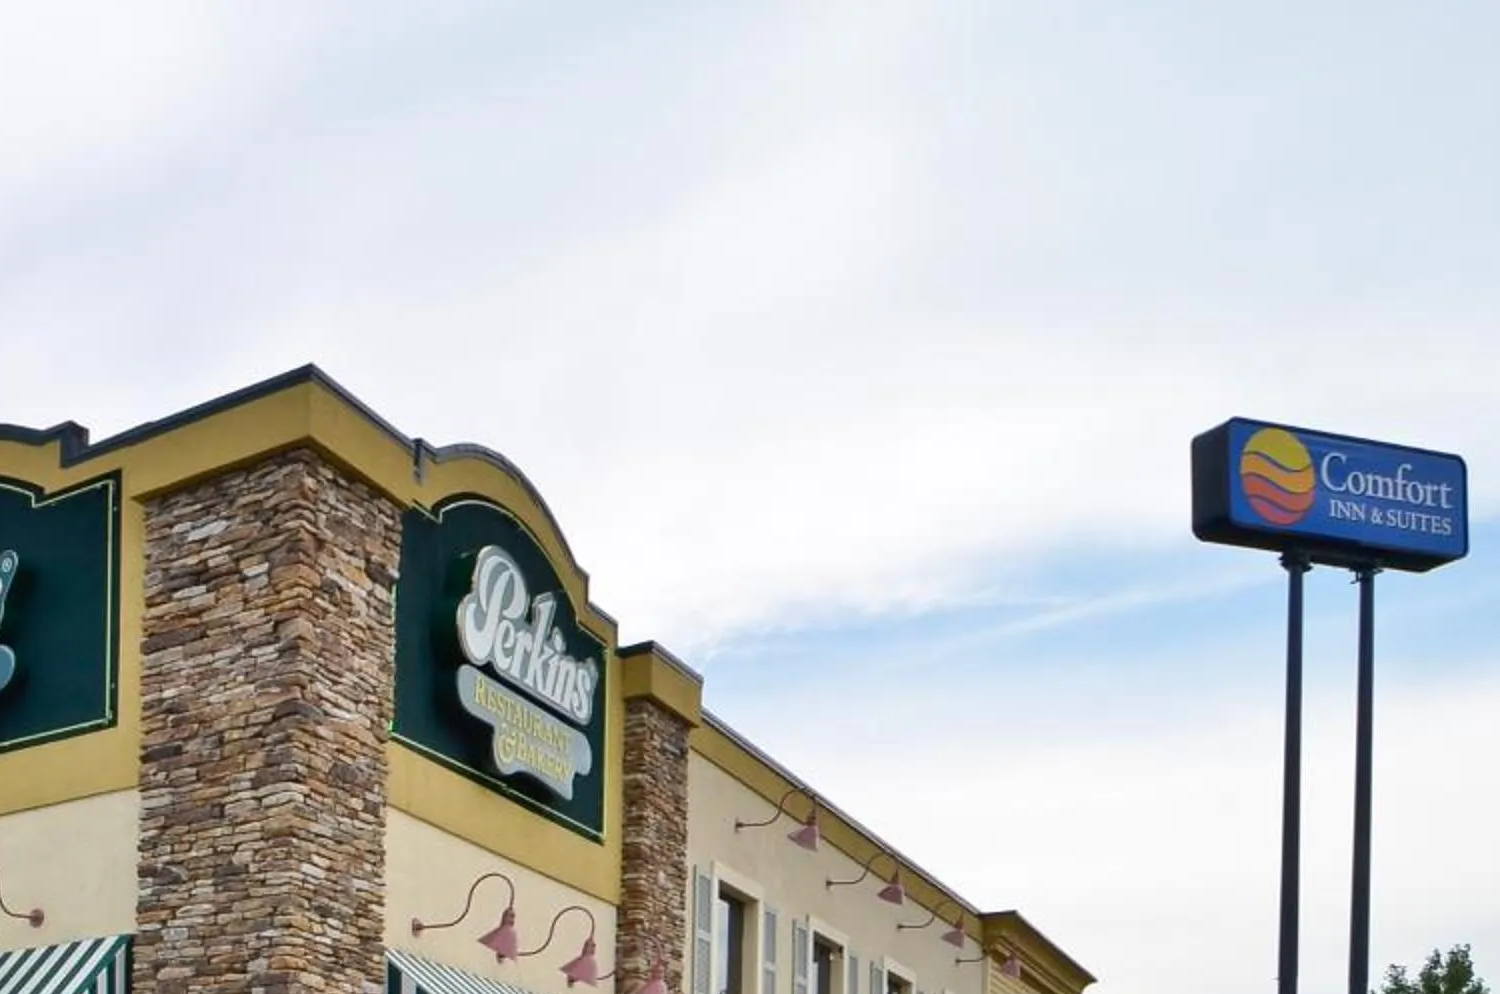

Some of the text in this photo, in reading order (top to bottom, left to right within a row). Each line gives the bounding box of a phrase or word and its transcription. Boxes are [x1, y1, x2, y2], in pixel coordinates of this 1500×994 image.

[1320, 451, 1452, 508] Comfort
[1329, 498, 1452, 536] INN & SUITES
[473, 673, 572, 755] RESTAURANT
